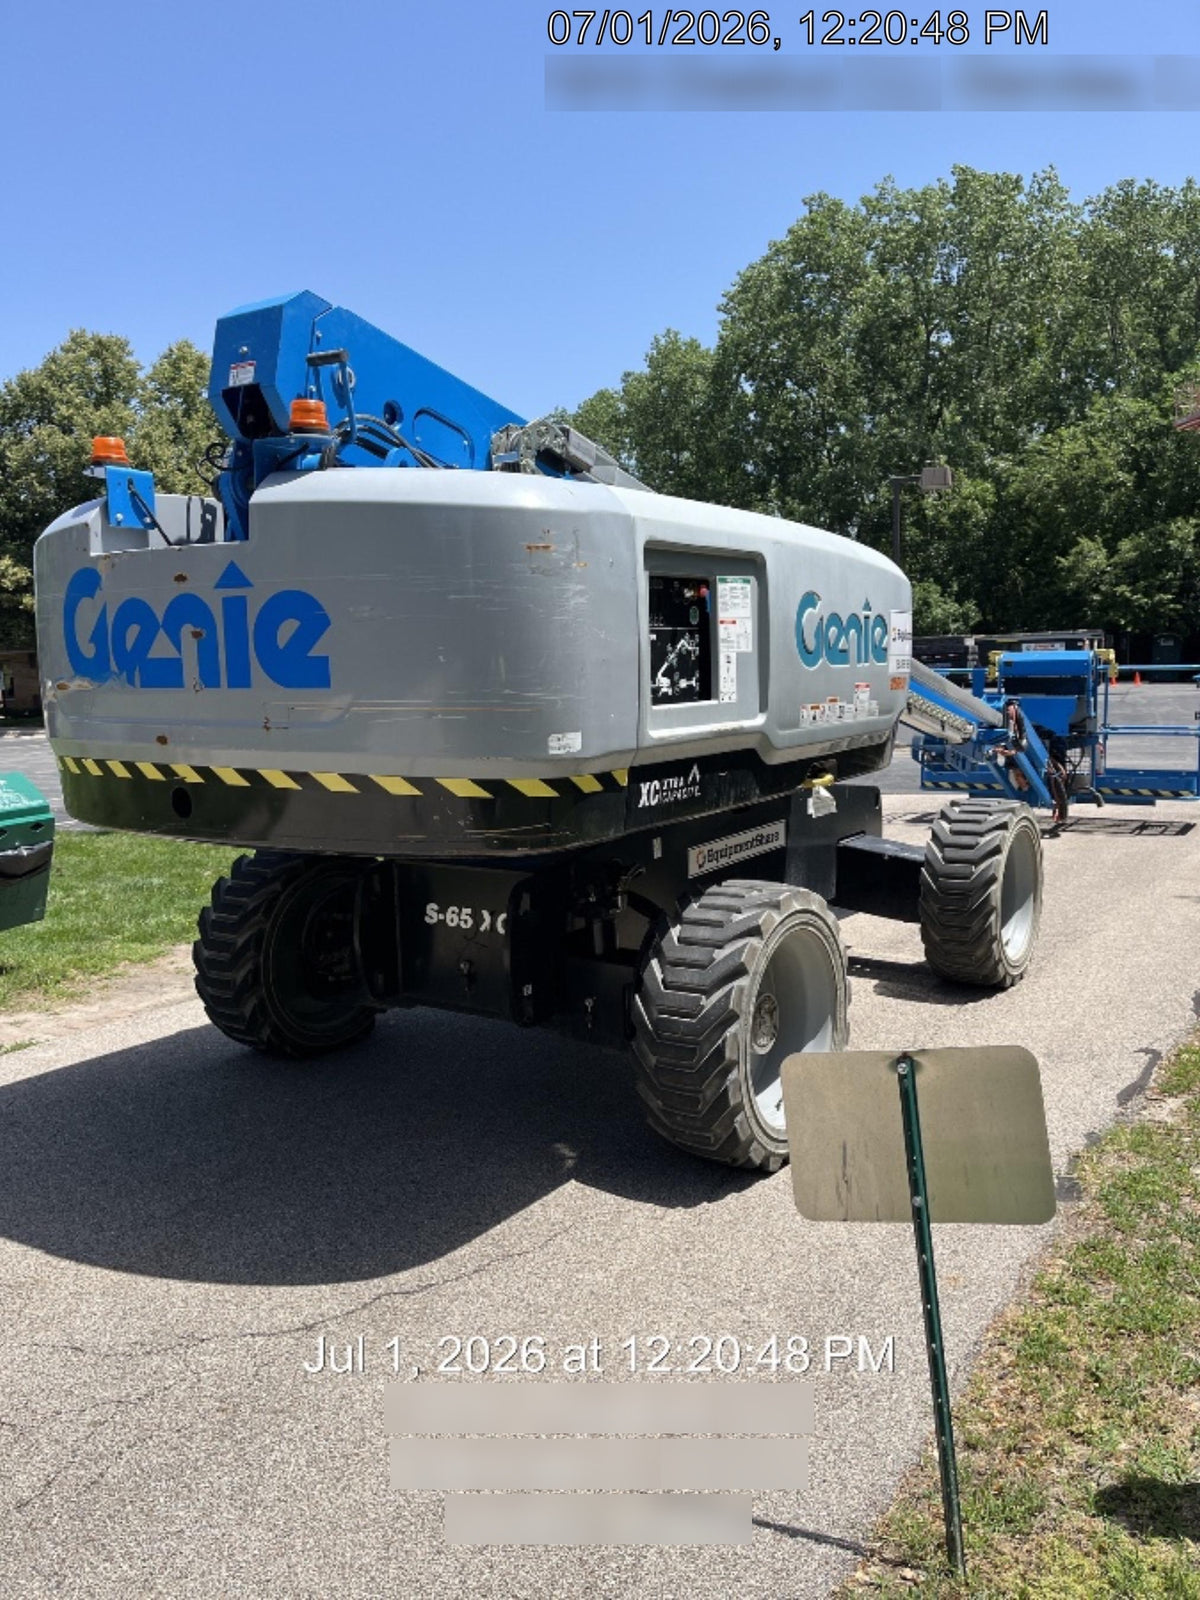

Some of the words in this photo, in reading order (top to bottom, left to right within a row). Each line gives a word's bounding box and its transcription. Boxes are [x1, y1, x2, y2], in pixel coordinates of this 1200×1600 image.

[63, 560, 331, 689] Genie
[795, 591, 888, 670] Genie
[638, 780, 660, 808] XC
[424, 902, 473, 929] S-65
